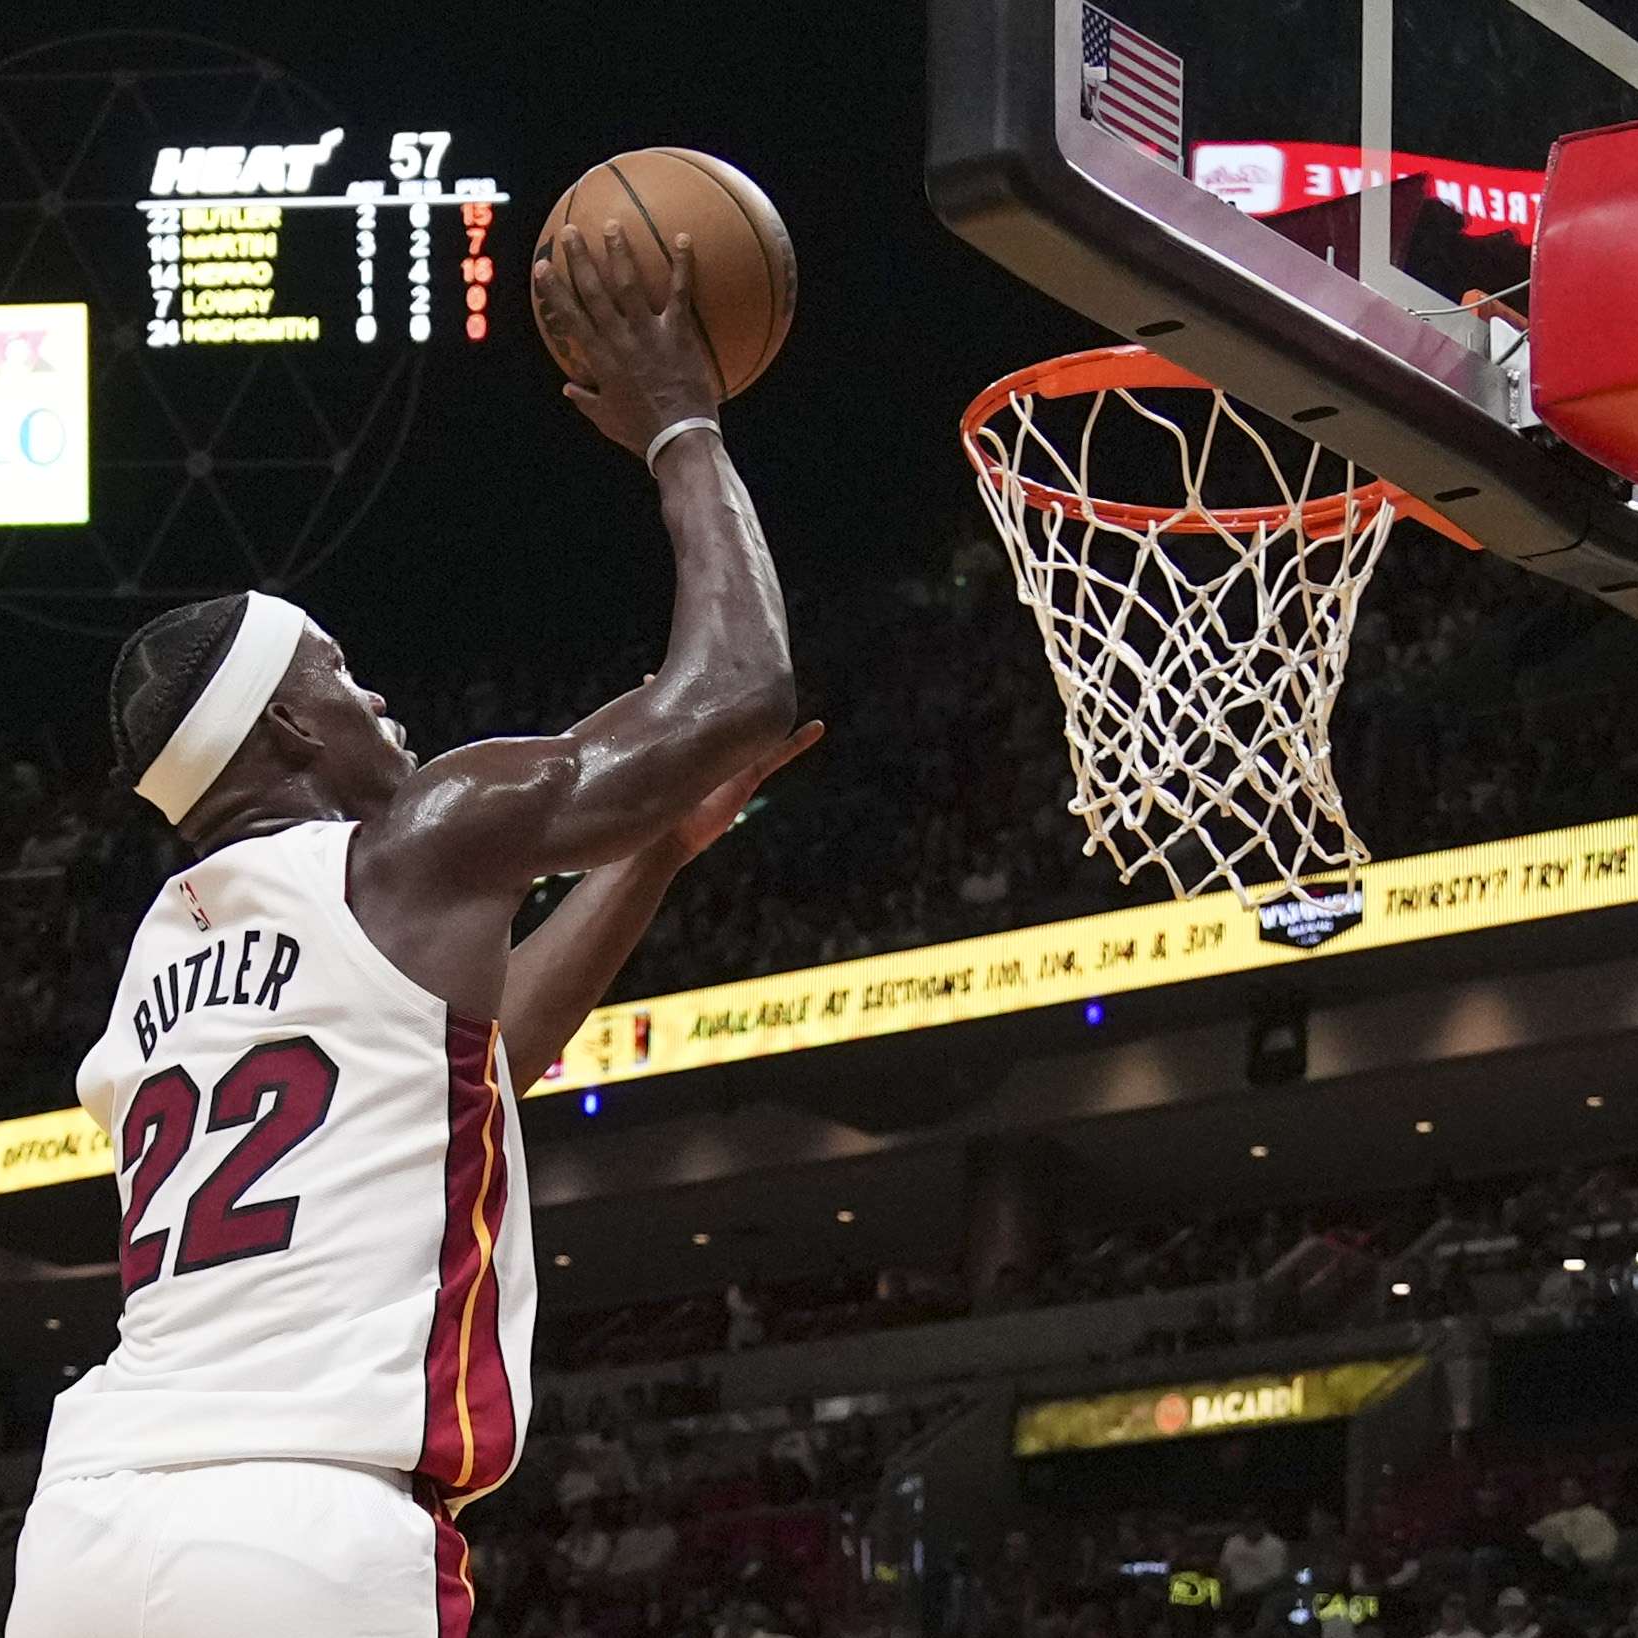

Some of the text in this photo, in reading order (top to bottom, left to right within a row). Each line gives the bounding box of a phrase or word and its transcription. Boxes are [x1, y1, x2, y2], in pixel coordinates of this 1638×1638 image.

[150, 128, 344, 195] HEAT
[389, 131, 451, 180] 57
[146, 208, 181, 235] 22
[356, 204, 376, 230] 2
[356, 230, 376, 258] 3
[409, 229, 431, 258] 2
[467, 227, 487, 255] 7
[357, 258, 374, 286] 1
[408, 258, 431, 285] 4
[152, 290, 174, 318] 7
[357, 286, 374, 314] 1
[409, 285, 431, 314] 2
[1384, 868, 1509, 916] THIRSTY?
[1519, 858, 1569, 893] TRY
[1581, 848, 1629, 881] THE
[134, 930, 300, 1062] BUTLER
[820, 990, 850, 1018] AT
[119, 1035, 340, 1297] 22
